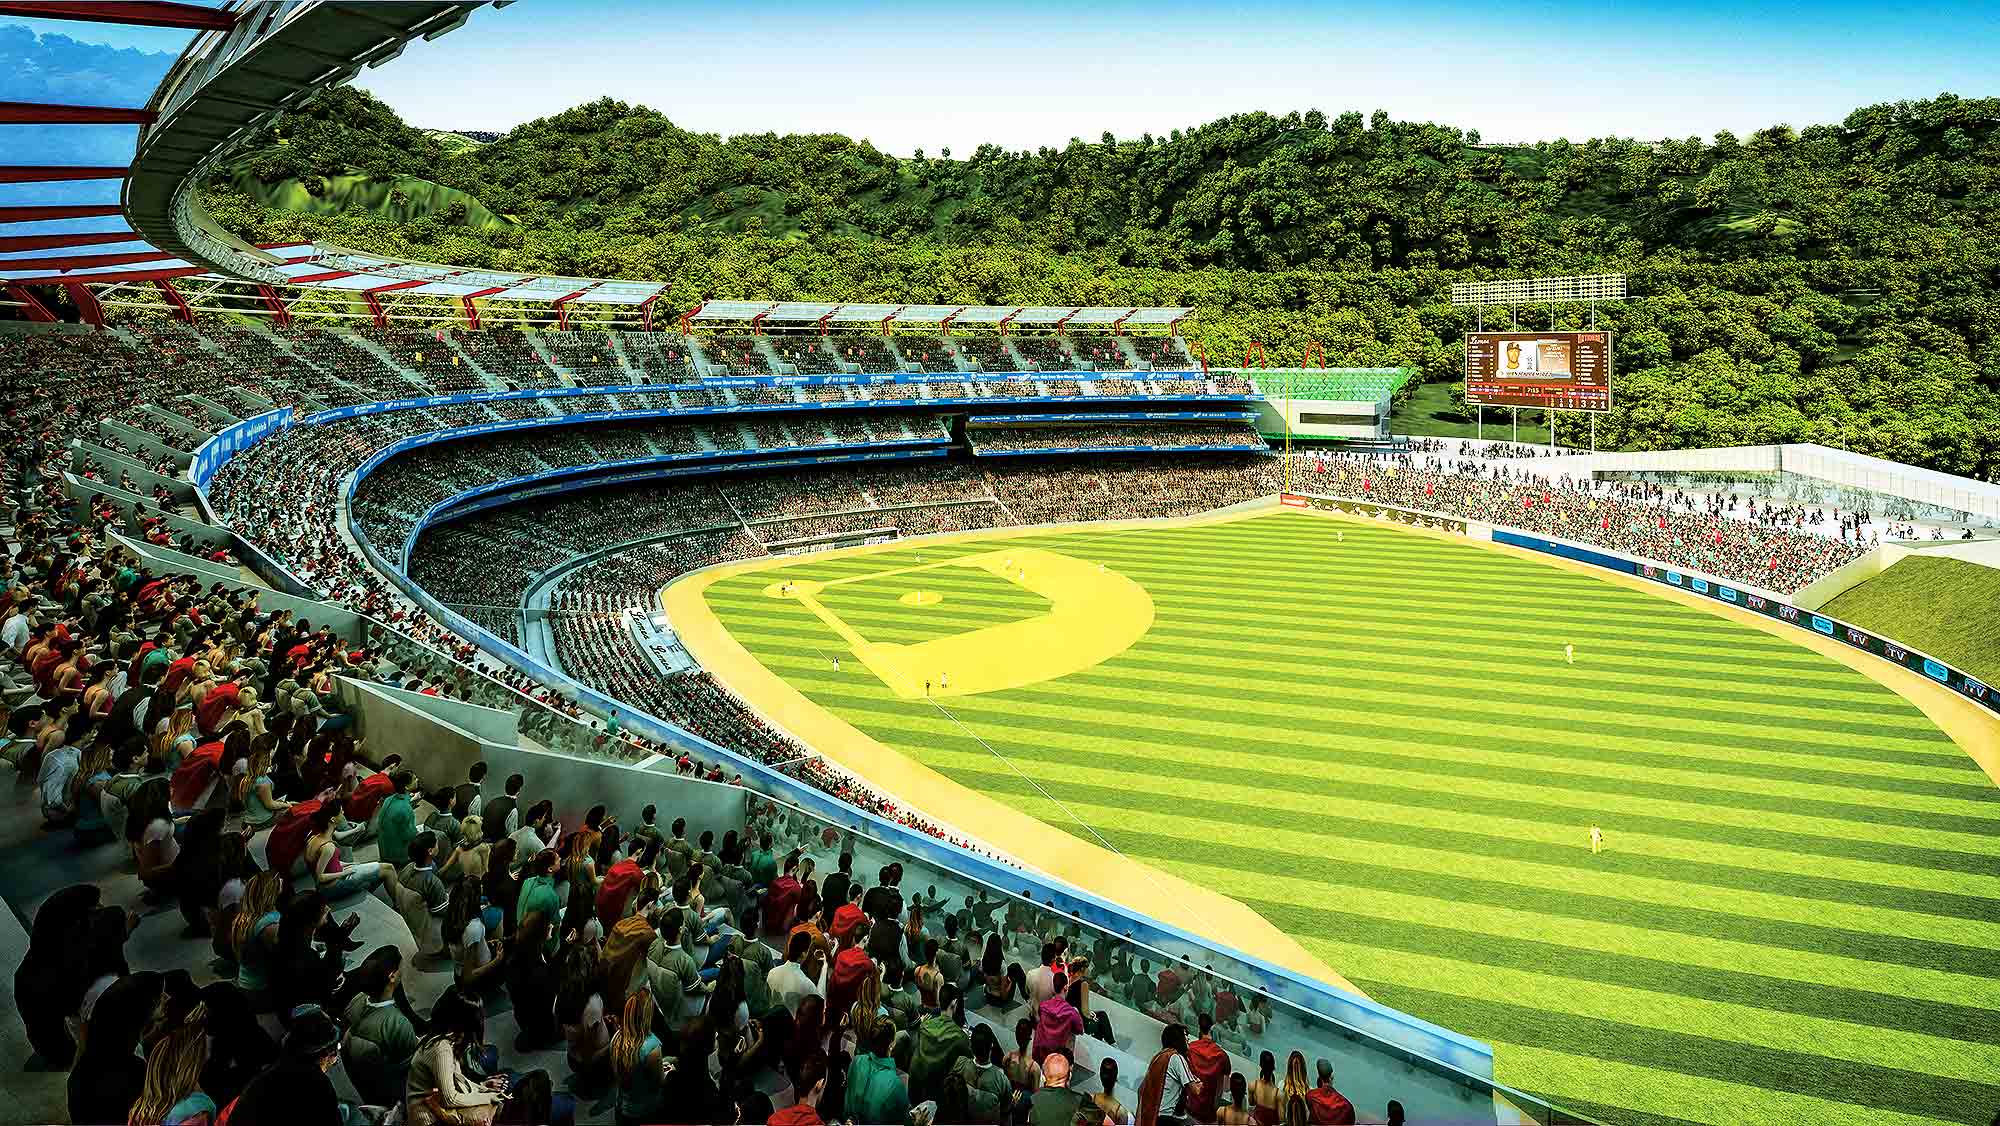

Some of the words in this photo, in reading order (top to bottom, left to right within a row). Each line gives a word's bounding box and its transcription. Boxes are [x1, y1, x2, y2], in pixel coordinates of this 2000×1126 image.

[1580, 399, 1587, 408] 3
[1590, 400, 1597, 408] 2
[1600, 400, 1607, 409] 1
[628, 609, 650, 640] Leones
[649, 645, 672, 671] Leones
